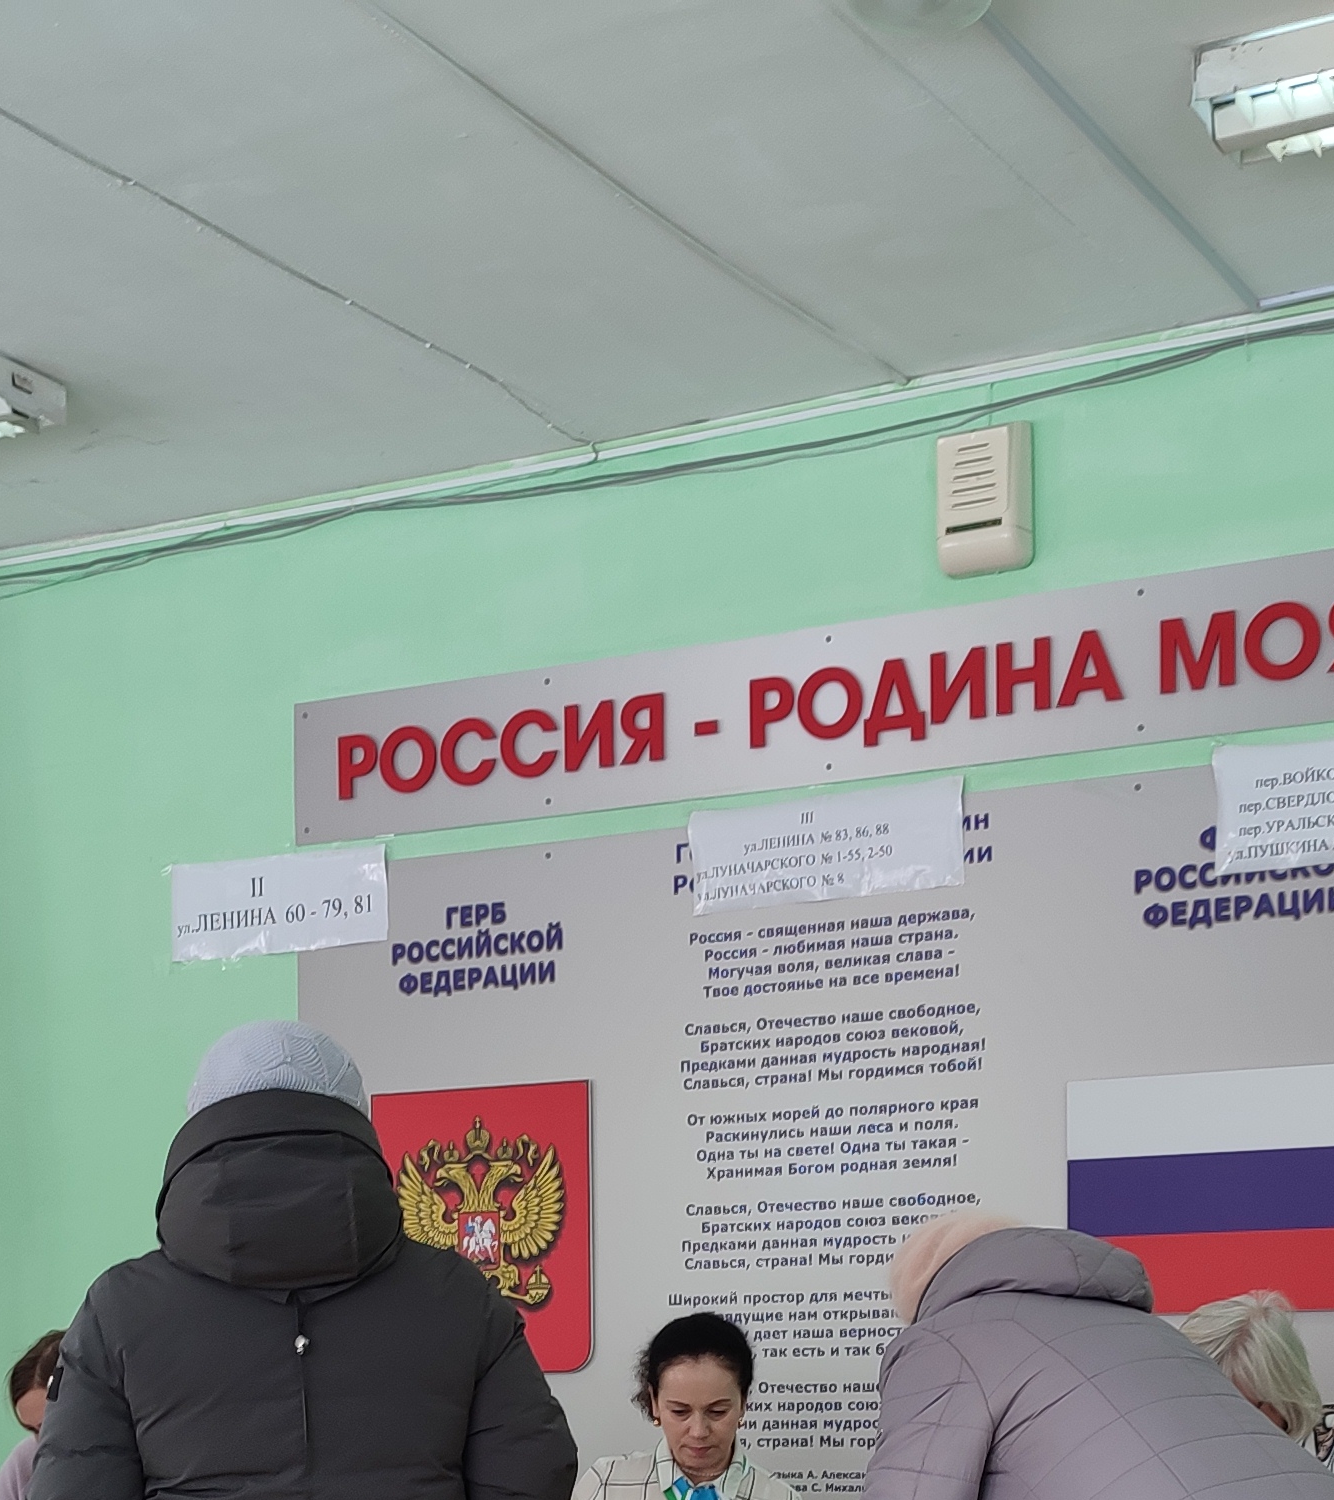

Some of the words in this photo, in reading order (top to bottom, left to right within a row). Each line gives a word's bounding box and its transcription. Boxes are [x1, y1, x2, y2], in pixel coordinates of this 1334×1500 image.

[337, 691, 666, 801] РОССИЯ
[749, 629, 1124, 749] РОДИНА
[743, 833, 815, 856] ул.ЛЕНИНА
[820, 831, 833, 845] №
[835, 828, 853, 842] 83,
[875, 823, 890, 836] 88
[820, 852, 833, 866] №
[250, 876, 265, 898] II
[821, 874, 835, 887] №
[837, 873, 845, 885] 8
[177, 906, 277, 938] ул.ЛЕНИНА
[285, 903, 306, 924] 60
[354, 894, 372, 914] 81
[446, 901, 506, 930] ГЕРБ
[690, 930, 741, 945] Россия
[758, 920, 844, 942] священная
[851, 916, 892, 931] наша
[898, 908, 975, 928] держава,
[391, 921, 563, 966] РОССИЙСКОЙ
[705, 947, 757, 962] Россия
[773, 939, 845, 956] любимая
[851, 934, 892, 950] наша
[709, 964, 771, 981] Могучая
[778, 960, 819, 974] воля,
[825, 953, 890, 970] великая
[896, 948, 942, 964] слава
[399, 959, 556, 997] ФЕДЕРАЦИИ
[703, 985, 738, 998] Твое
[744, 978, 823, 997] достоянье
[829, 976, 847, 988] на
[853, 973, 879, 986] все
[885, 963, 959, 986] времена!
[685, 1021, 751, 1037] Славься,
[757, 1014, 836, 1031] Отечество
[842, 1011, 883, 1024] наше
[889, 1003, 980, 1022] свободное,
[701, 1038, 770, 1056] Братских
[776, 1032, 840, 1050] народов
[846, 1029, 885, 1043] союз
[892, 1019, 963, 1039] вековой,
[681, 1058, 755, 1075] Предками
[761, 1052, 816, 1069] данная
[823, 1047, 896, 1066] мудрость
[902, 1037, 985, 1059] народная!
[684, 1073, 749, 1091] Славься,
[755, 1068, 811, 1088] страна!
[818, 1064, 842, 1082] Мы
[849, 1063, 923, 1082] гордимся
[929, 1056, 982, 1074] тобой!
[688, 1114, 705, 1127] От
[710, 1111, 766, 1126] южных
[772, 1104, 819, 1124] морей
[825, 1107, 843, 1121] до
[850, 1100, 934, 1118] полярного
[941, 1098, 978, 1113] края
[706, 1128, 804, 1144] Раскинулись
[810, 1124, 851, 1138] наши
[857, 1122, 893, 1135] леса
[900, 1122, 908, 1132] и
[697, 1150, 734, 1163] Одна
[739, 1149, 758, 1160] ты
[764, 1147, 781, 1159] на
[787, 1142, 834, 1158] свете!
[841, 1141, 879, 1156] Одна
[885, 1140, 905, 1152] ты
[911, 1137, 956, 1150] такая
[707, 1166, 782, 1182] Хранимая
[789, 1162, 834, 1176] Богом
[841, 1159, 897, 1176] родная
[903, 1154, 957, 1169] земля!
[686, 1203, 751, 1217] Славься,
[758, 1199, 836, 1213] Отечество
[843, 1197, 883, 1210] наше
[889, 1193, 980, 1212] свободное,
[702, 1220, 771, 1237] Братских
[777, 1218, 841, 1232] народов
[847, 1216, 885, 1228] союз
[682, 1239, 756, 1256] Предками
[762, 1237, 817, 1251] данная
[824, 1234, 896, 1250] мудрость
[685, 1257, 750, 1270] Славься,
[756, 1254, 812, 1271] страна!
[819, 1252, 843, 1266] Мы
[669, 1291, 737, 1309] Широкий
[744, 1292, 804, 1307] простор
[809, 1291, 837, 1305] для
[789, 1310, 817, 1322] нам
[754, 1329, 788, 1343] дает
[793, 1328, 833, 1339] наша
[840, 1326, 903, 1340] верност
[762, 1347, 787, 1357] так
[793, 1347, 825, 1358] есть
[831, 1346, 839, 1356] и
[845, 1346, 870, 1357] так
[759, 1382, 837, 1394] Отечество
[778, 1402, 842, 1415] народов
[848, 1402, 882, 1412] сою
[762, 1419, 817, 1431] данная
[824, 1419, 879, 1432] мудрос
[757, 1435, 813, 1451] страна!
[820, 1435, 844, 1448] Мы
